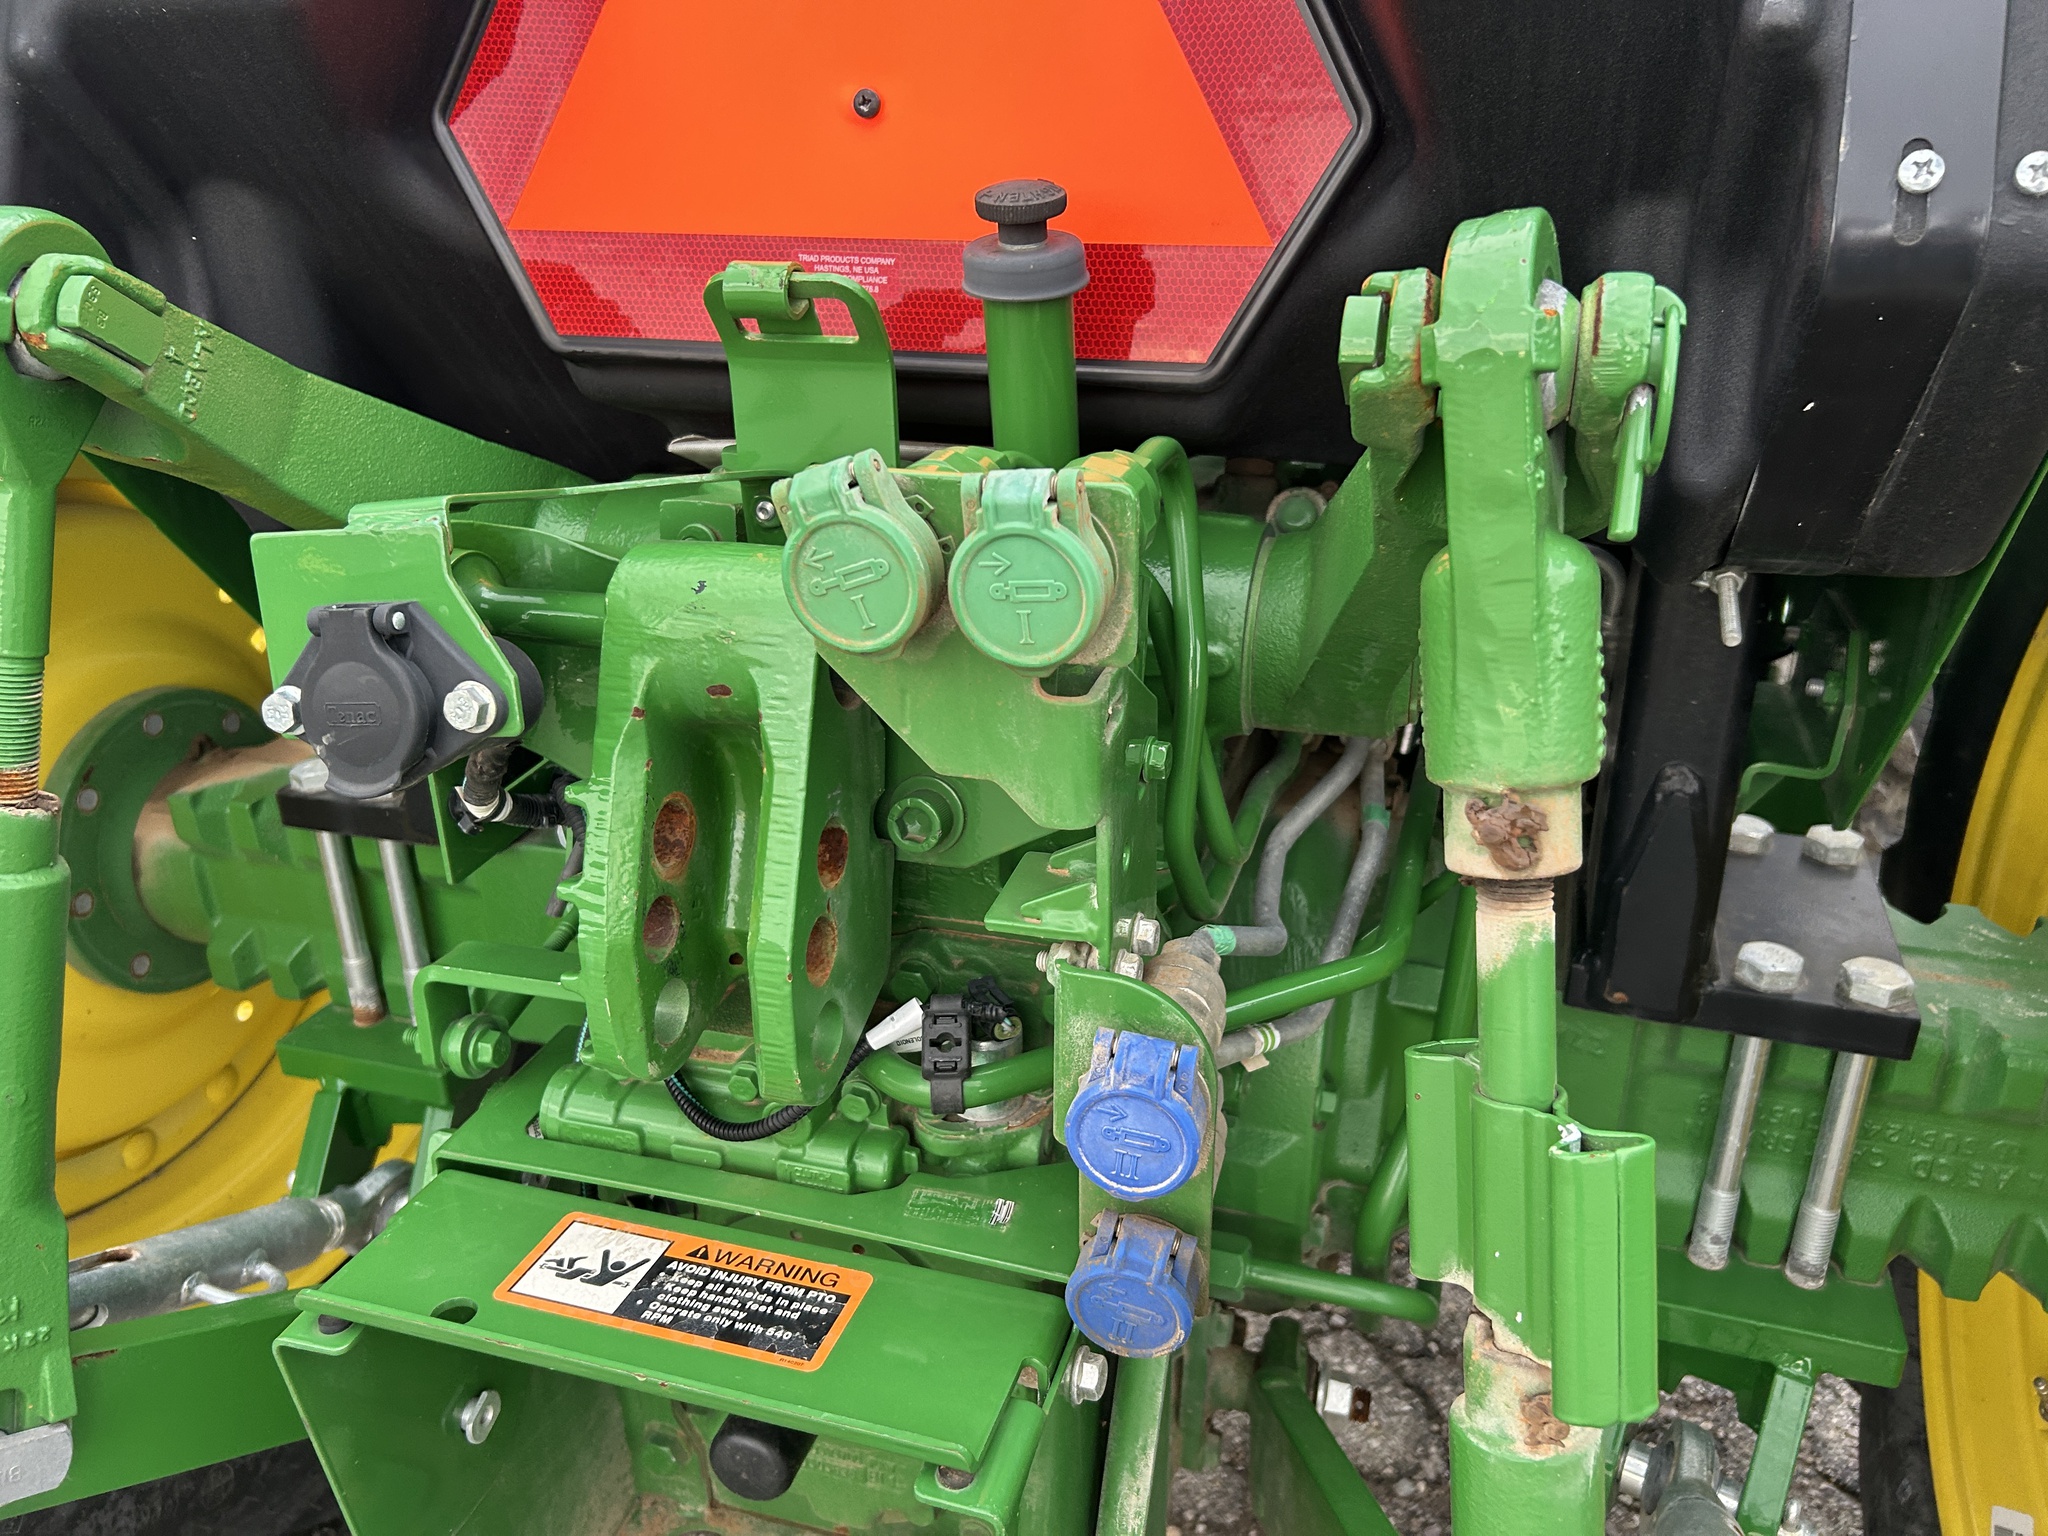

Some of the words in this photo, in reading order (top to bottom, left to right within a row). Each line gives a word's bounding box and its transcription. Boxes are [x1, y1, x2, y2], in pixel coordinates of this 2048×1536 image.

[798, 254, 819, 262] TRIAD
[820, 255, 860, 265] PRODUCTS
[860, 257, 896, 266] COMPANY
[814, 265, 852, 274] HASTINGS,
[853, 266, 863, 274] NE
[864, 267, 879, 275] USA
[847, 275, 888, 284] OMPLIANCE
[327, 706, 377, 723] Tenac
[895, 1036, 922, 1047] OLENOID
[714, 1248, 840, 1288] WARNING
[666, 1260, 711, 1276] AVOID
[711, 1269, 764, 1288] INJURY
[762, 1280, 805, 1298] FROM
[806, 1290, 836, 1304] PTO
[663, 1282, 698, 1297] Keep
[699, 1290, 742, 1308] hands,
[744, 1301, 774, 1314] feet
[774, 1308, 801, 1320] and
[670, 1273, 704, 1289] Keep
[705, 1283, 725, 1293] all
[725, 1286, 773, 1303] shields
[775, 1296, 790, 1307] in
[790, 1301, 829, 1315] place
[640, 1310, 674, 1325] RPM
[648, 1301, 702, 1320] Operate
[703, 1314, 734, 1329] only
[734, 1320, 764, 1334] with
[656, 1293, 712, 1312] clothing
[711, 1305, 748, 1320] away
